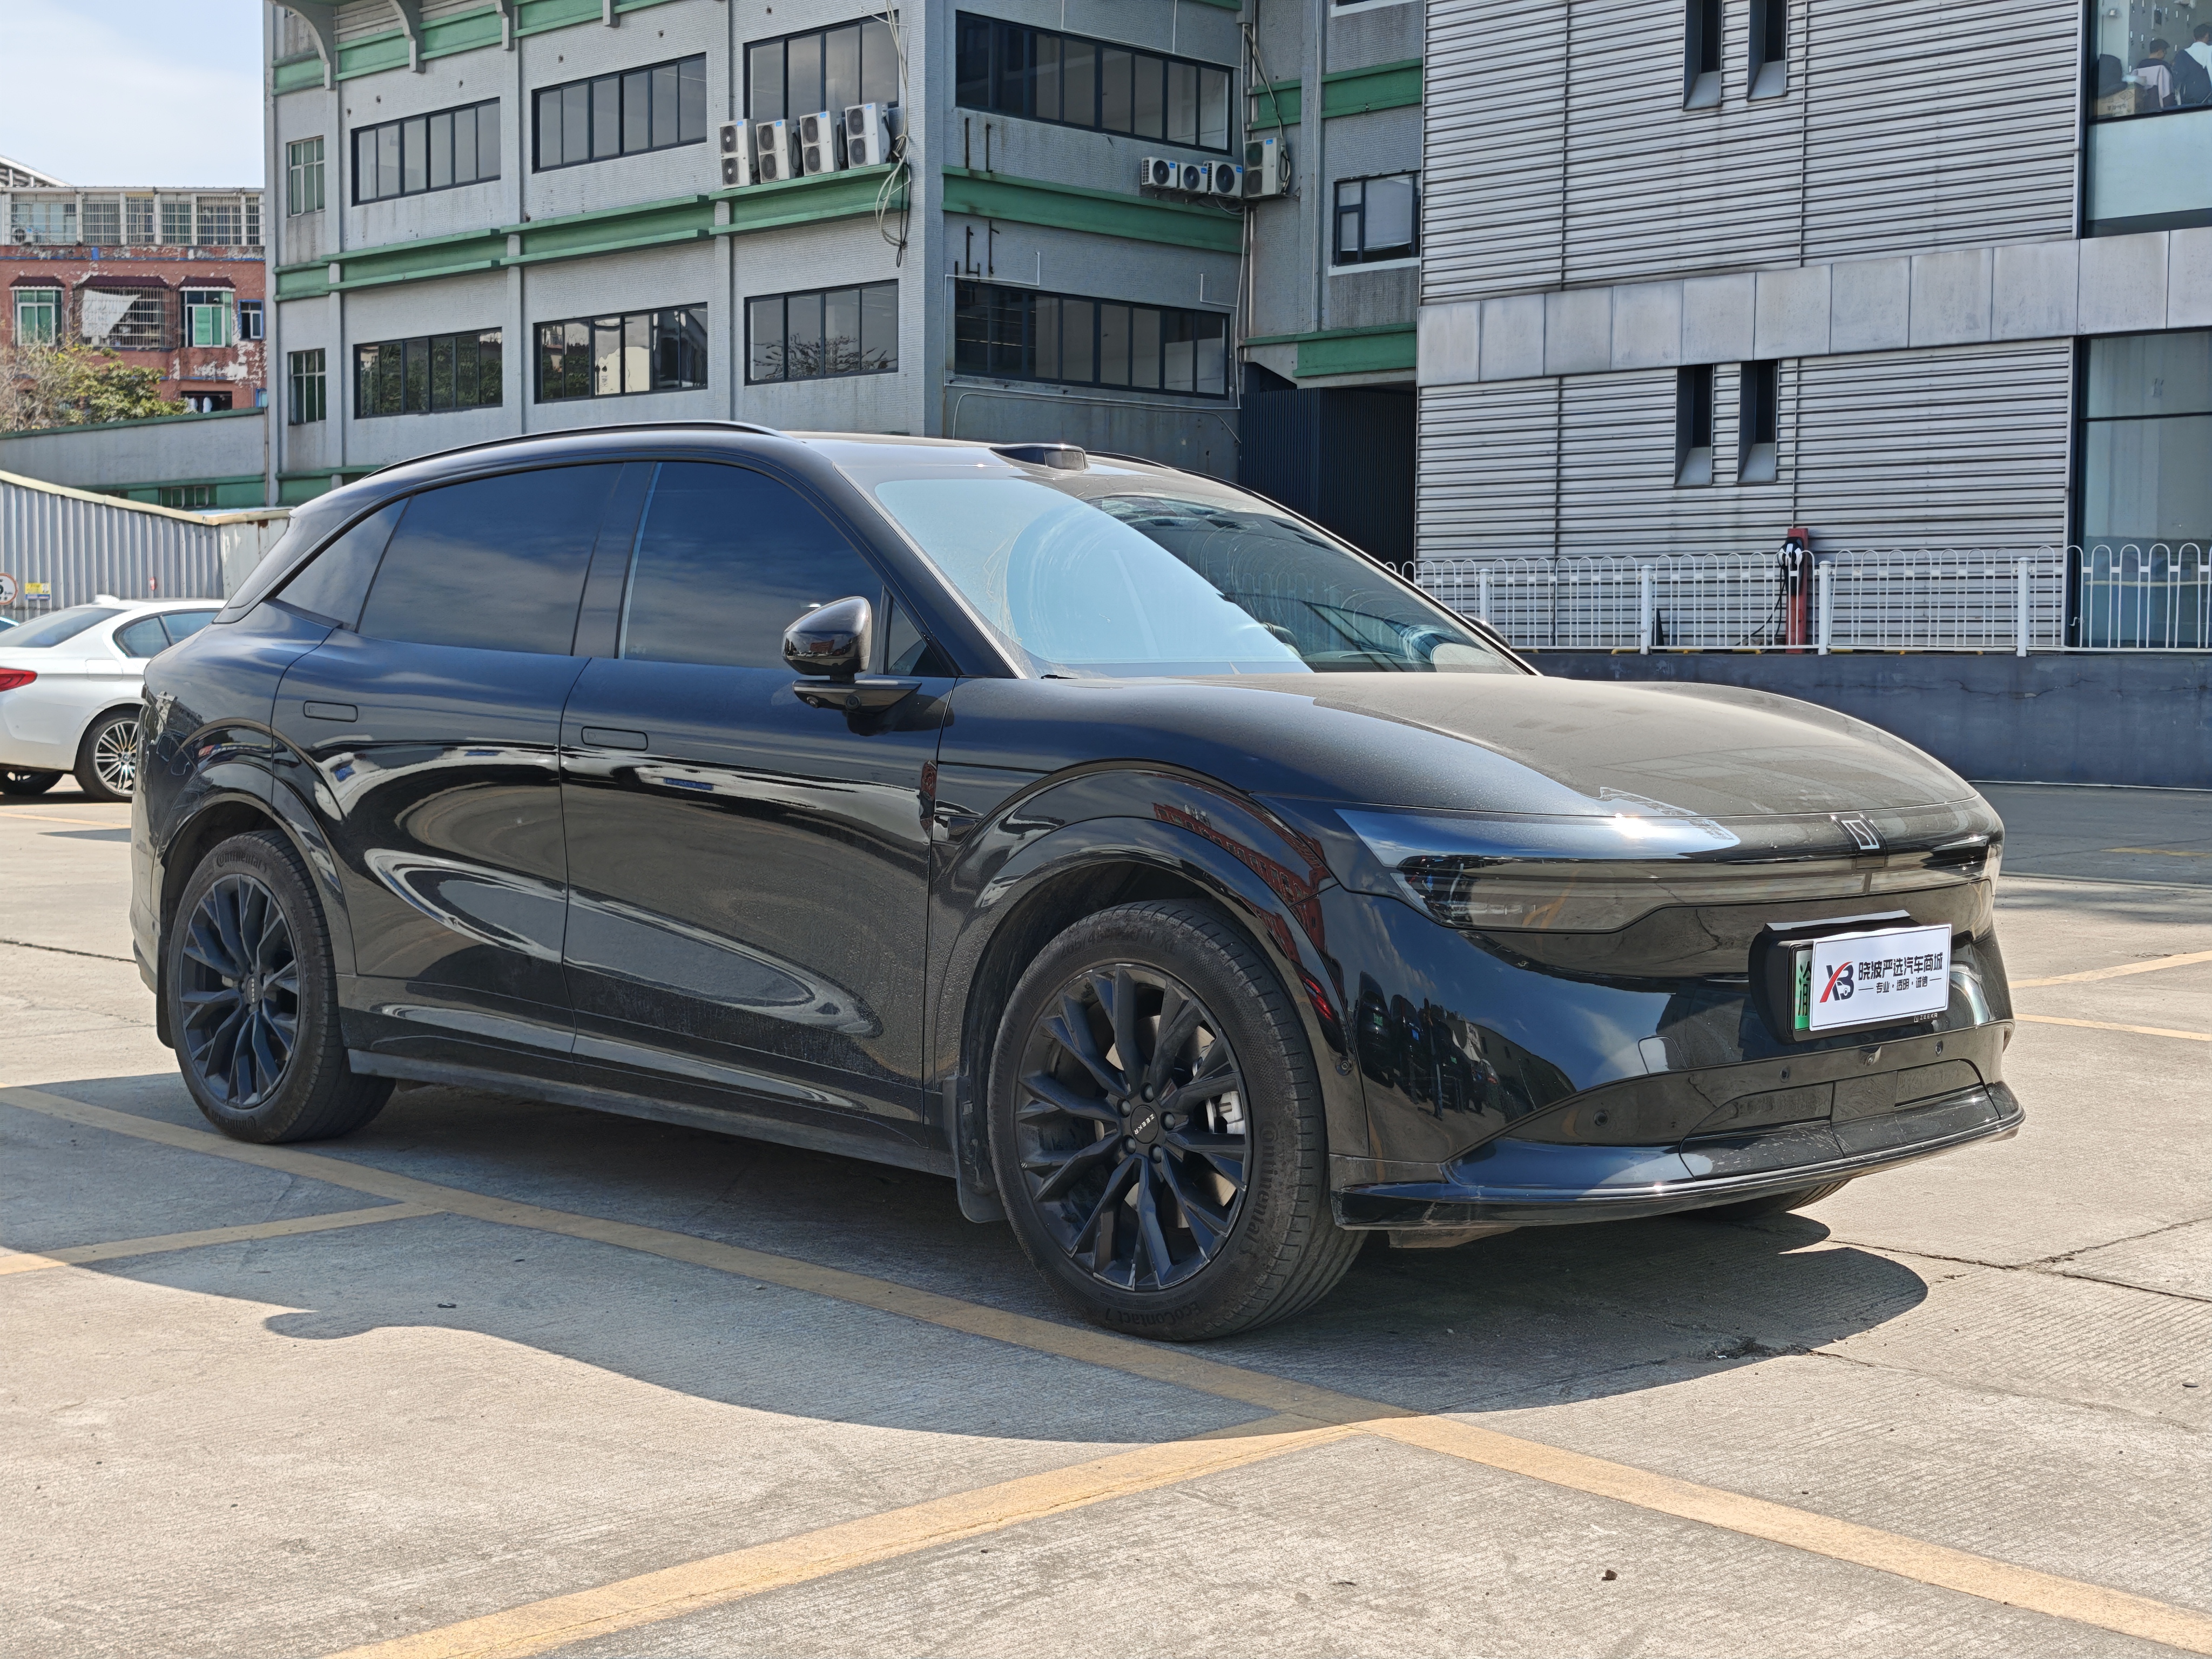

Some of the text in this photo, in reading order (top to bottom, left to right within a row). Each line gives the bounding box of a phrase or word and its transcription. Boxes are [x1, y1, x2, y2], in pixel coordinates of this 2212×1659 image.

[1858, 952, 1943, 981] 晓波严选汽车商城
[1134, 1114, 1155, 1135] ZEEKR
[1244, 1121, 1278, 1243] Continental
[1118, 1300, 1203, 1327] EcoContact
